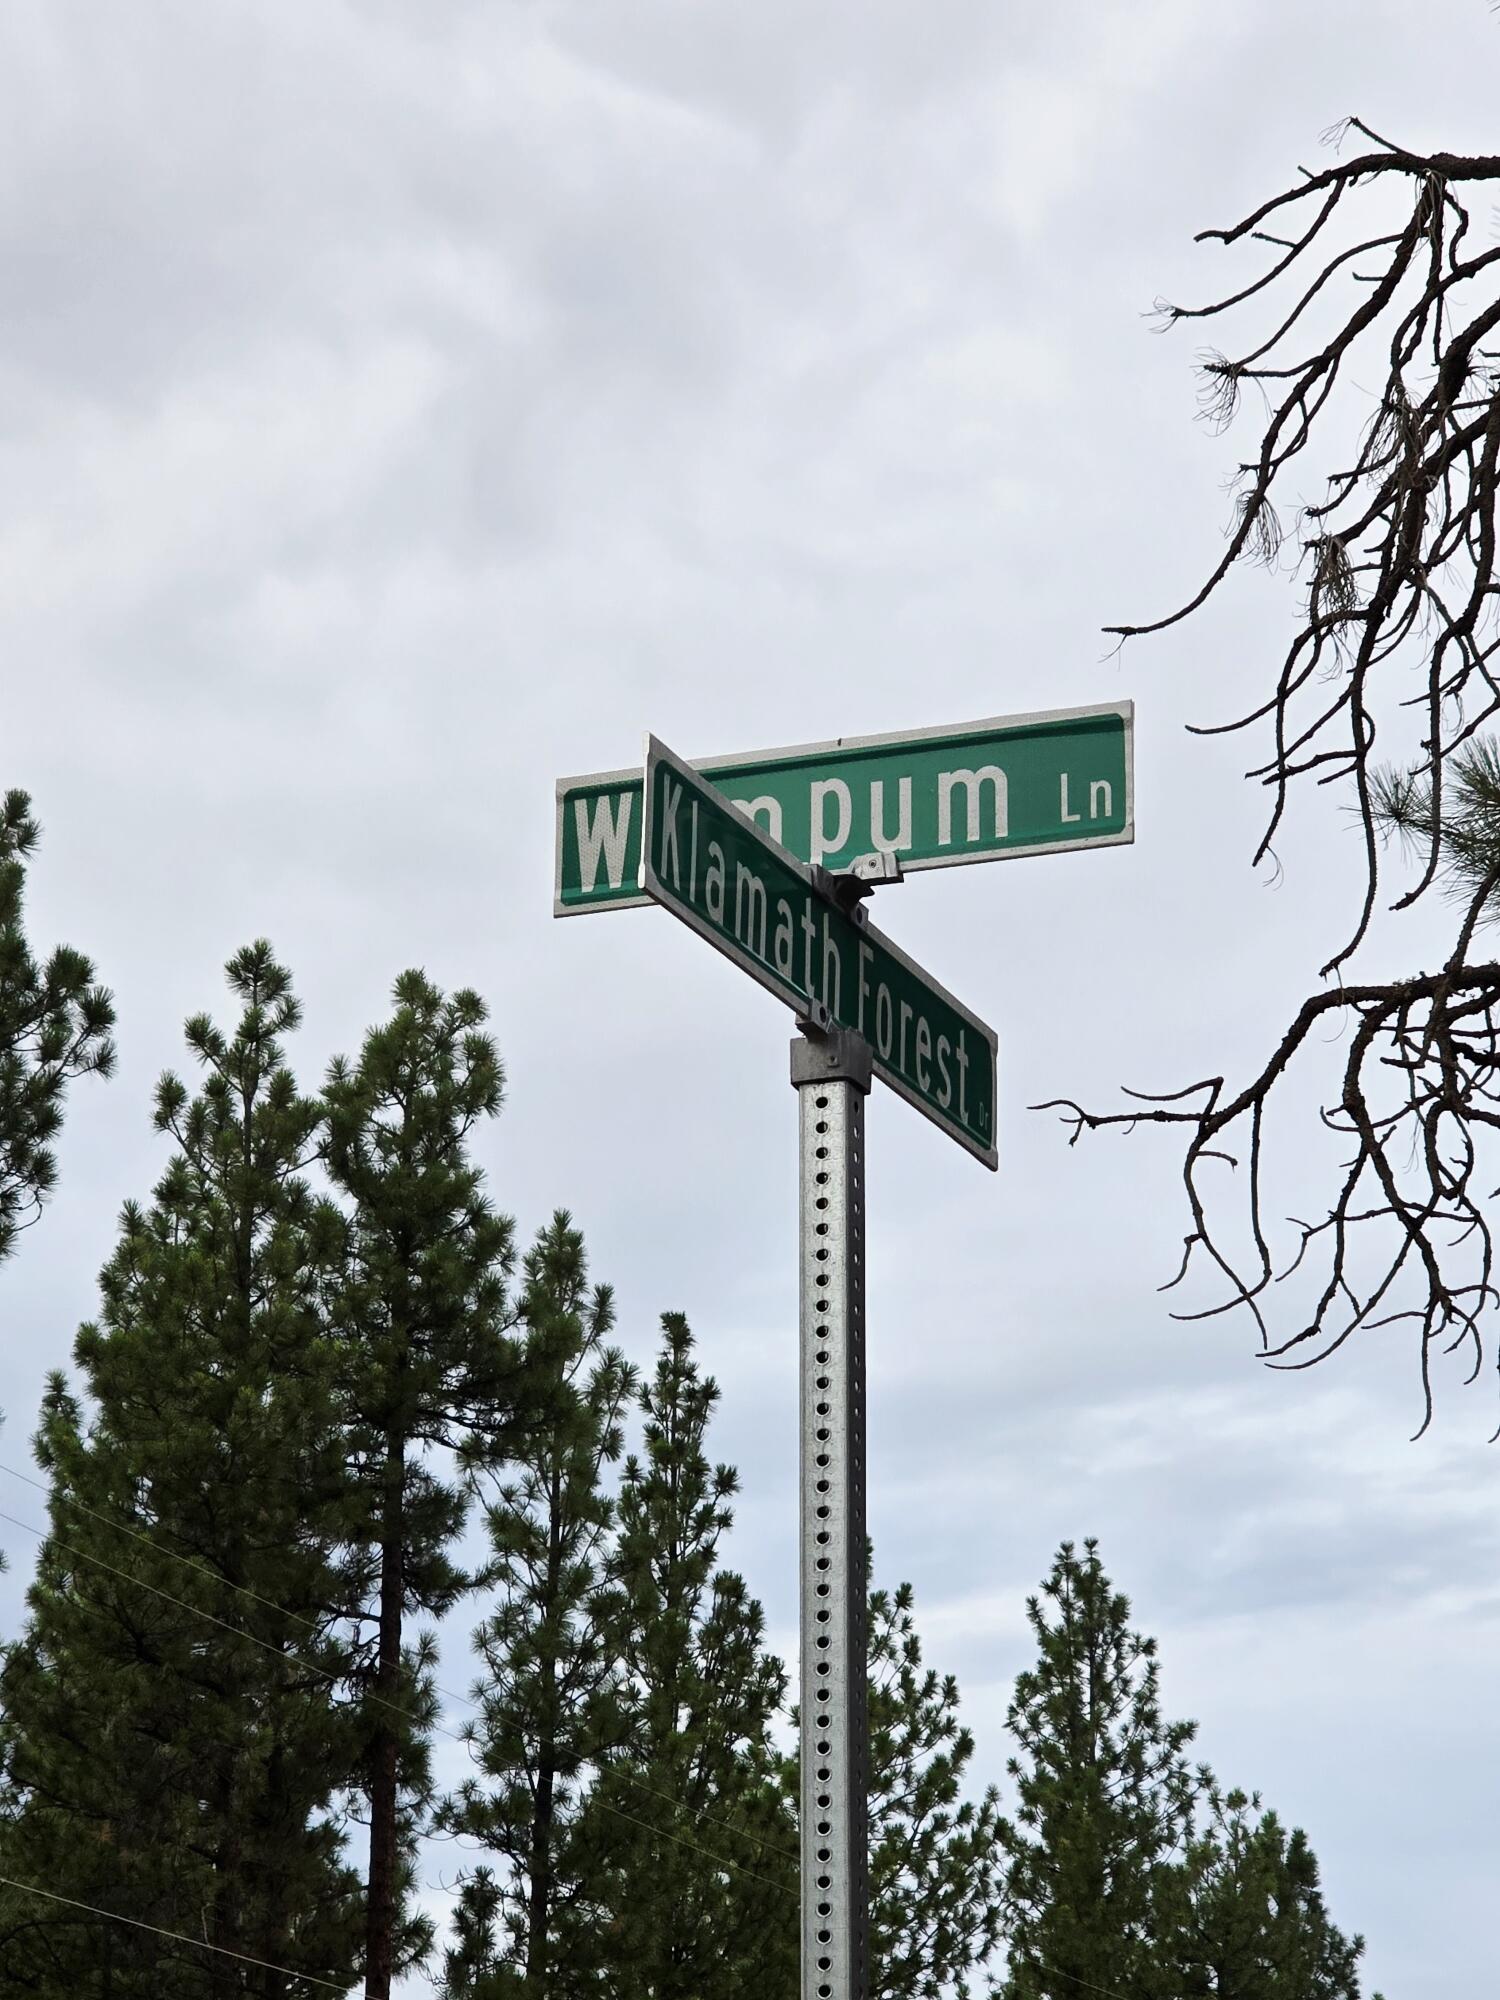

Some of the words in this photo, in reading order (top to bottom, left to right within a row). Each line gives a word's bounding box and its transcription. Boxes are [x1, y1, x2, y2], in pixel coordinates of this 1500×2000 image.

[574, 765, 1009, 893] Wpum
[1060, 773, 1112, 823] Ln
[660, 773, 841, 1019] Klamath
[858, 939, 970, 1125] Forest
[979, 1102, 989, 1130] Dr
